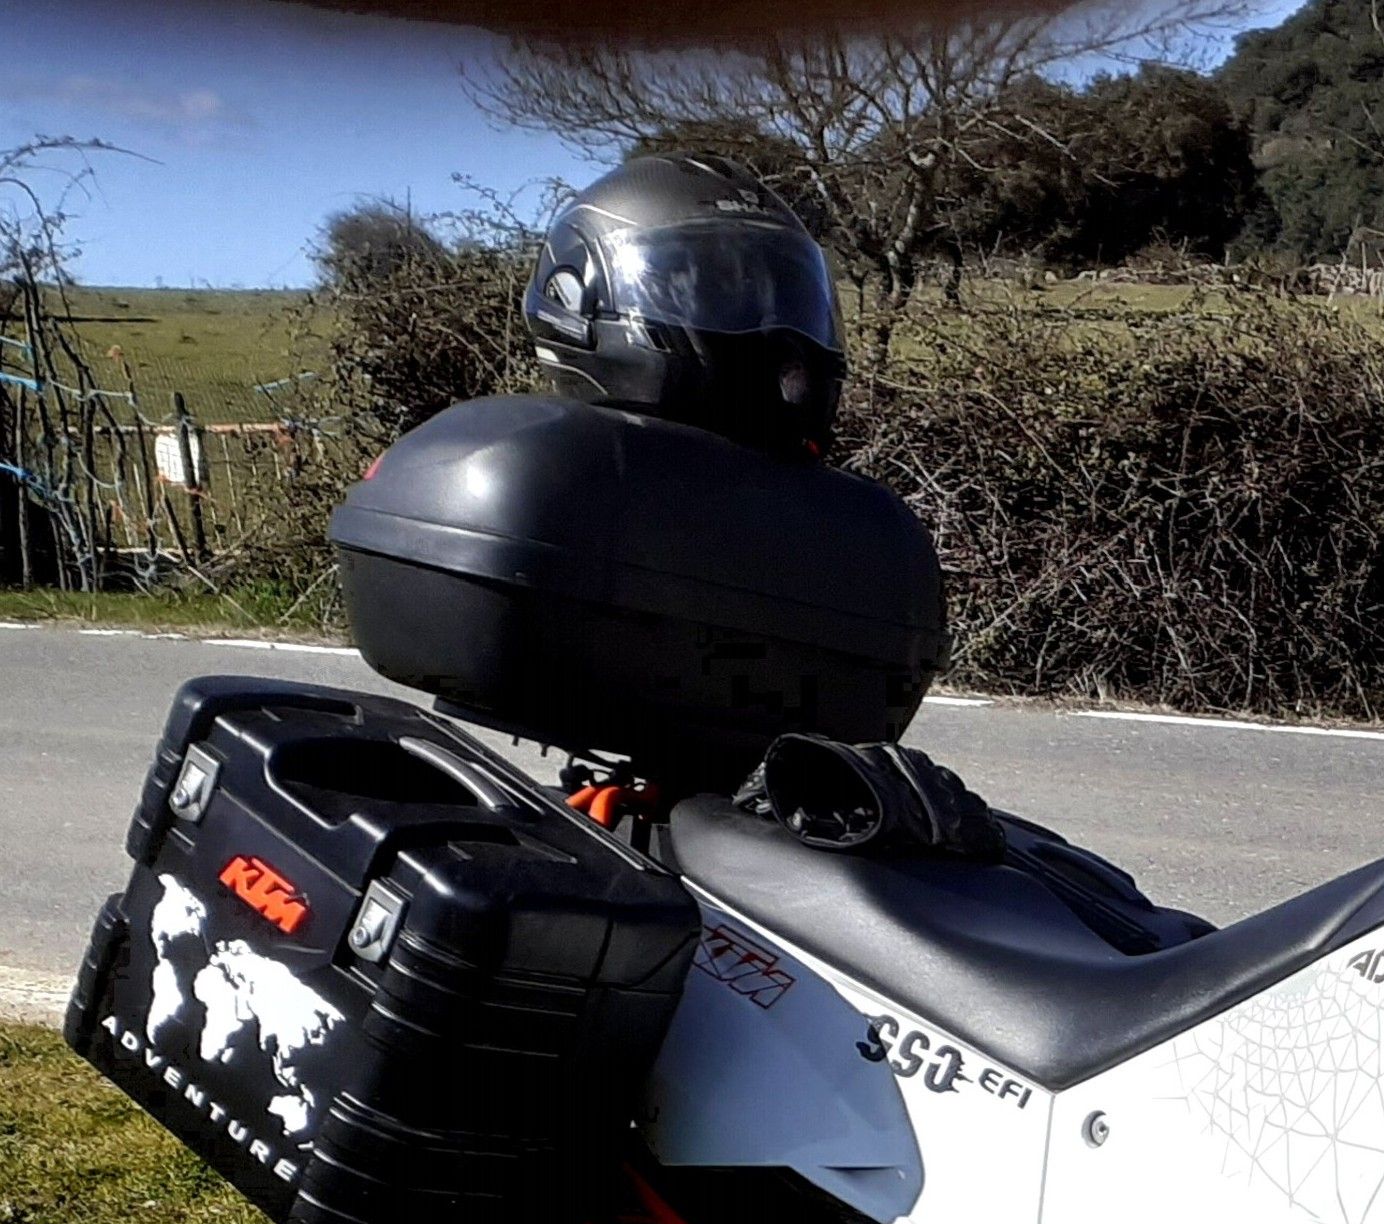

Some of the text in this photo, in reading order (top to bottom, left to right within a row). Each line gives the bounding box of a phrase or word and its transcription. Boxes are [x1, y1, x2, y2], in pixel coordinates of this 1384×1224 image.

[219, 856, 306, 933] KTM
[101, 1015, 298, 1183] ADVENTURE
[978, 1067, 1033, 1110] EFI
